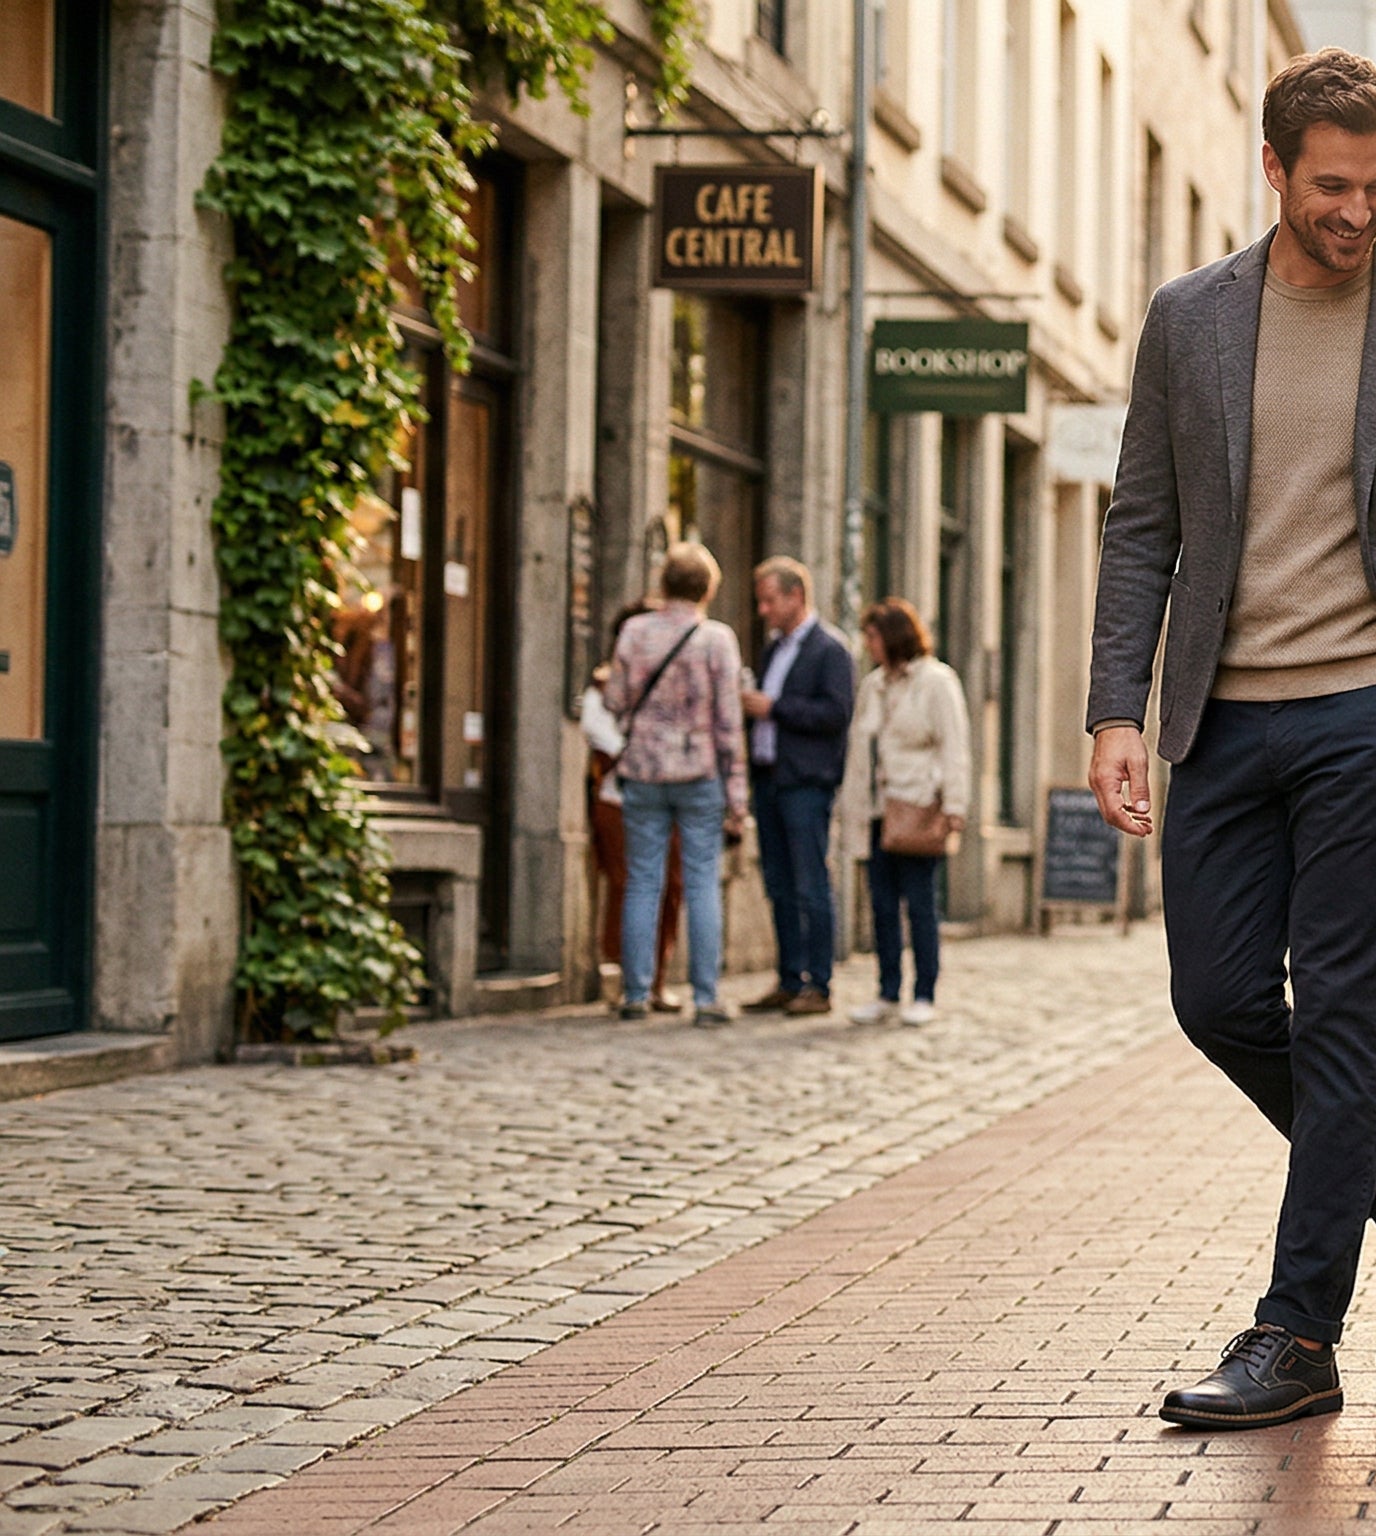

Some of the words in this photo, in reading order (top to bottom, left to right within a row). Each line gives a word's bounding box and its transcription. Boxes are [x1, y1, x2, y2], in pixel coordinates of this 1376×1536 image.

[696, 183, 773, 223] CAFE
[665, 227, 802, 267] CENTRAL
[875, 348, 1027, 377] BOOKSHOP
